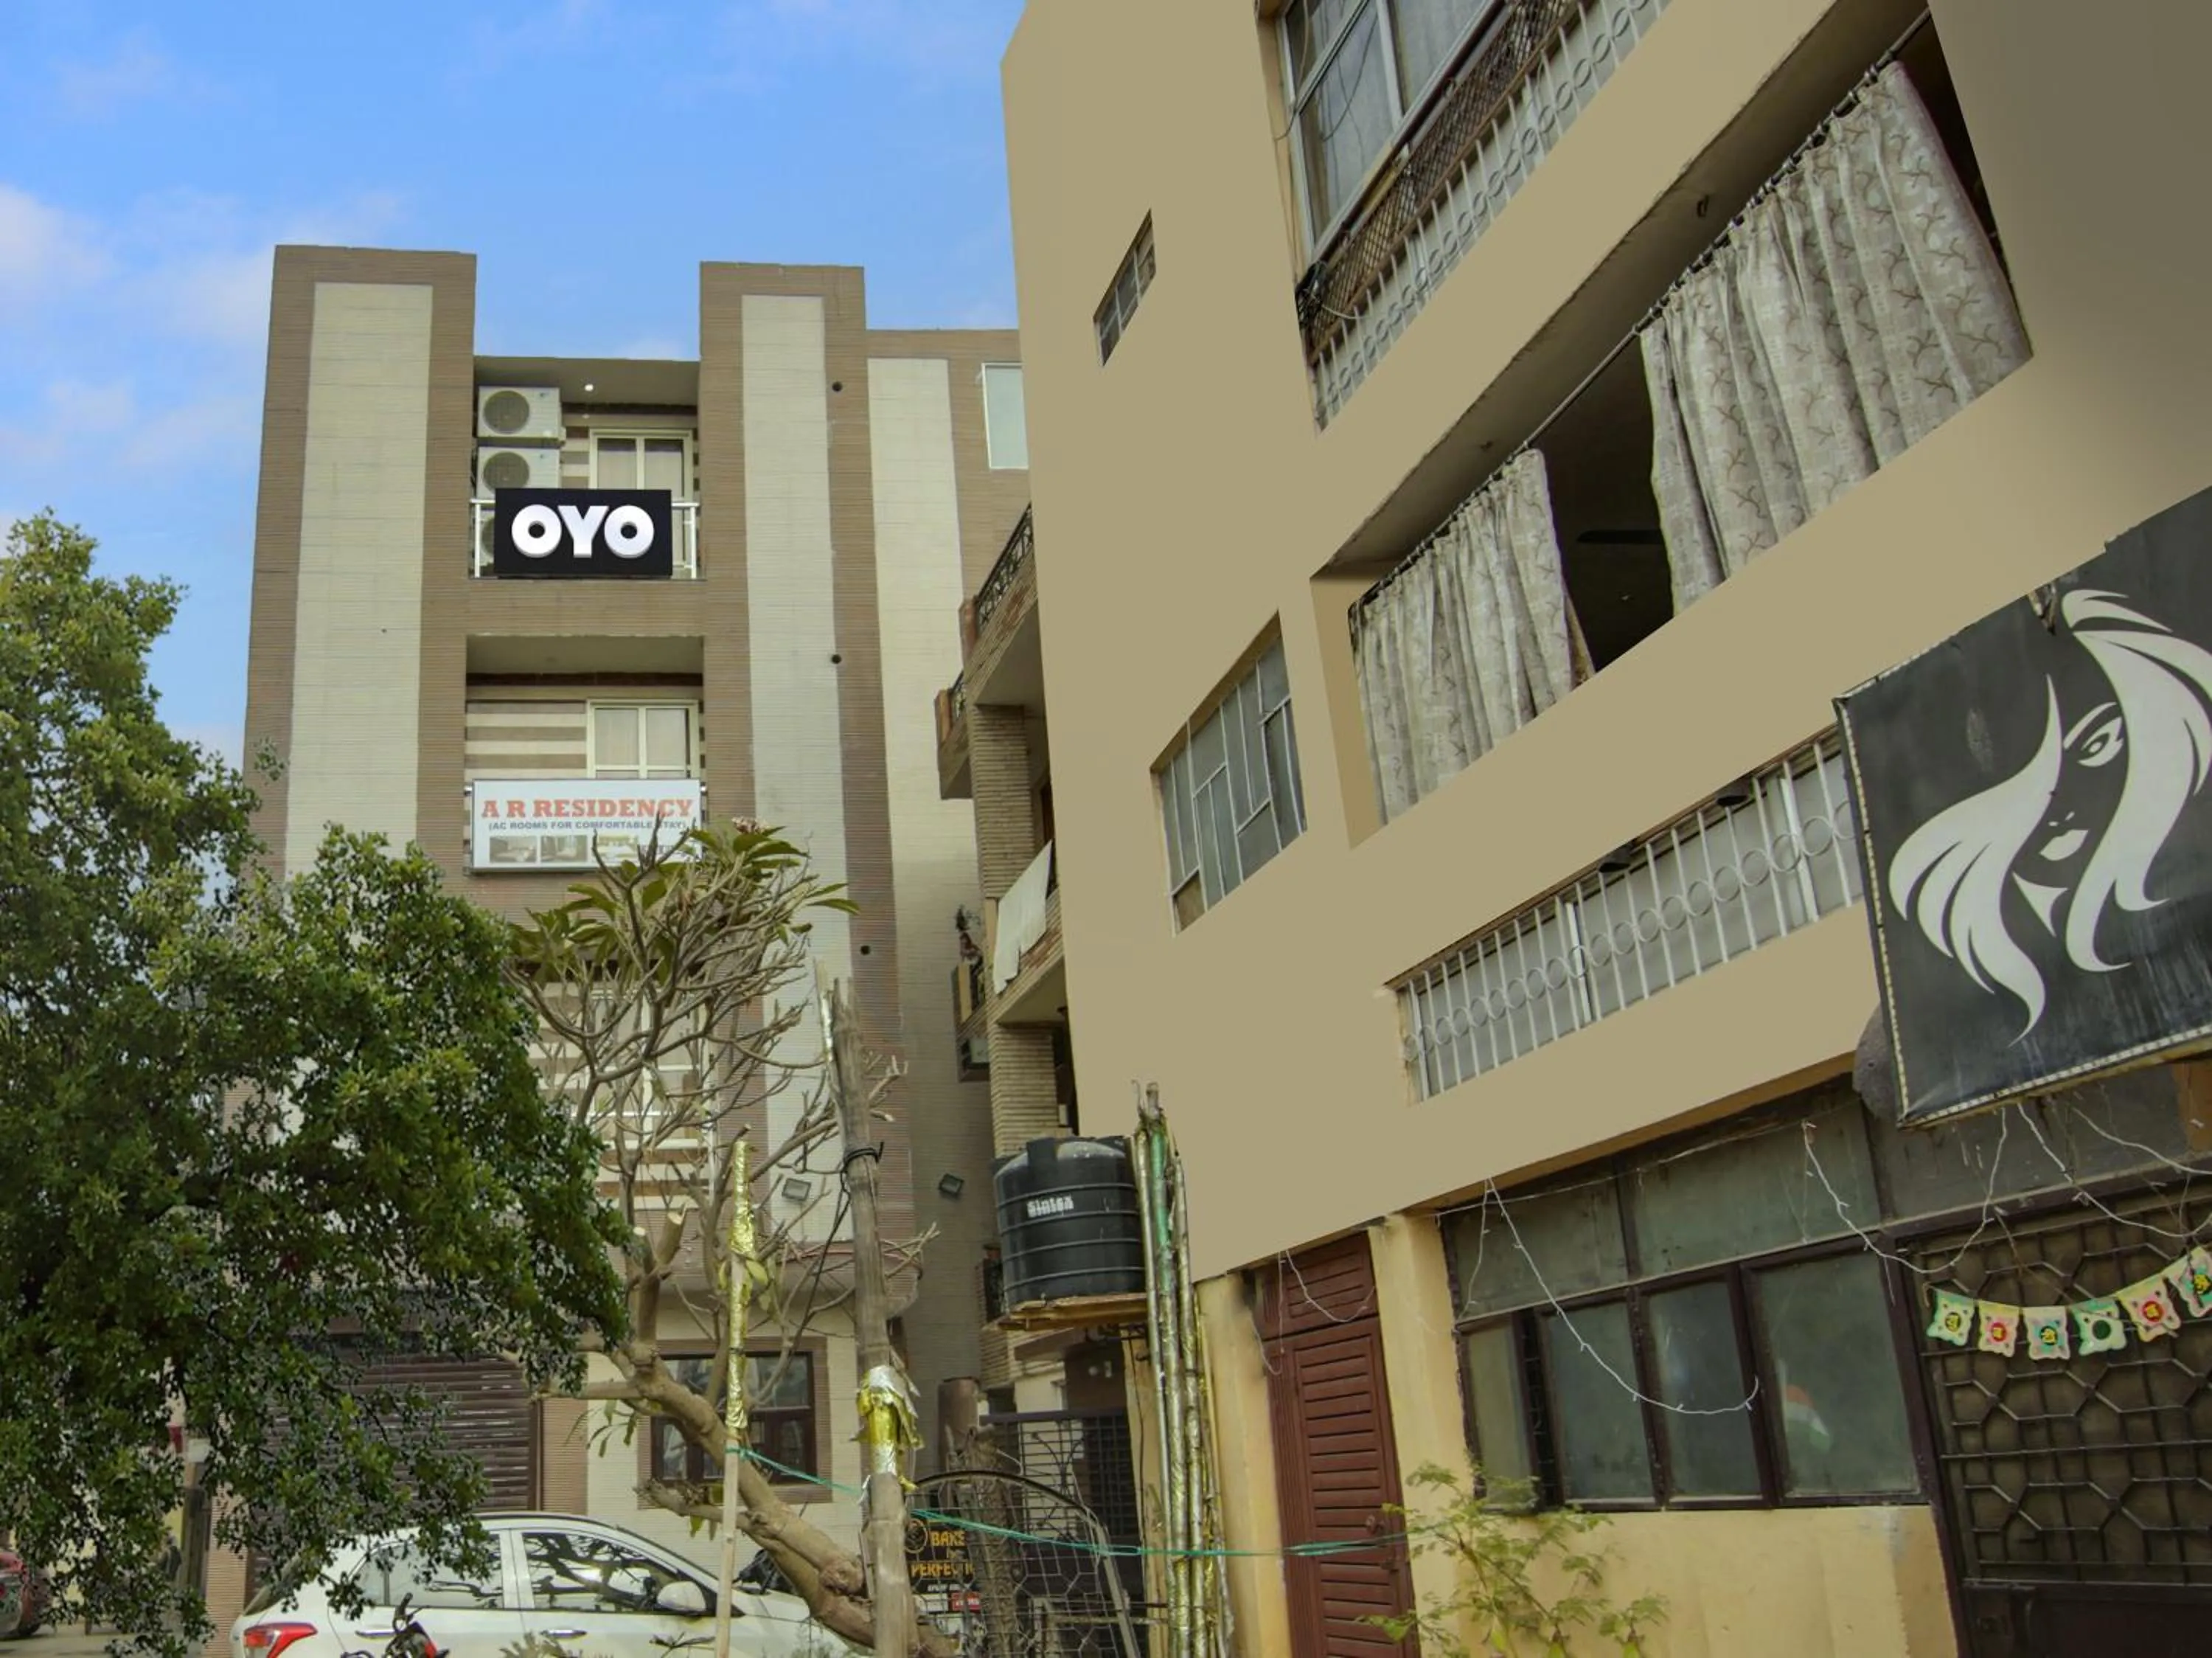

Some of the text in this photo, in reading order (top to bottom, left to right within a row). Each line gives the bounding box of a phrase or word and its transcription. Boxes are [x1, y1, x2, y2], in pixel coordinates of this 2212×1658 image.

[511, 504, 655, 558] OYO
[481, 799, 693, 818] A R RESIDENCY
[509, 821, 548, 830] ROOMS
[551, 821, 572, 830] FOR
[575, 820, 650, 829] COMFORTABLE
[658, 820, 686, 829] TAY)
[930, 1530, 965, 1546] BAKE
